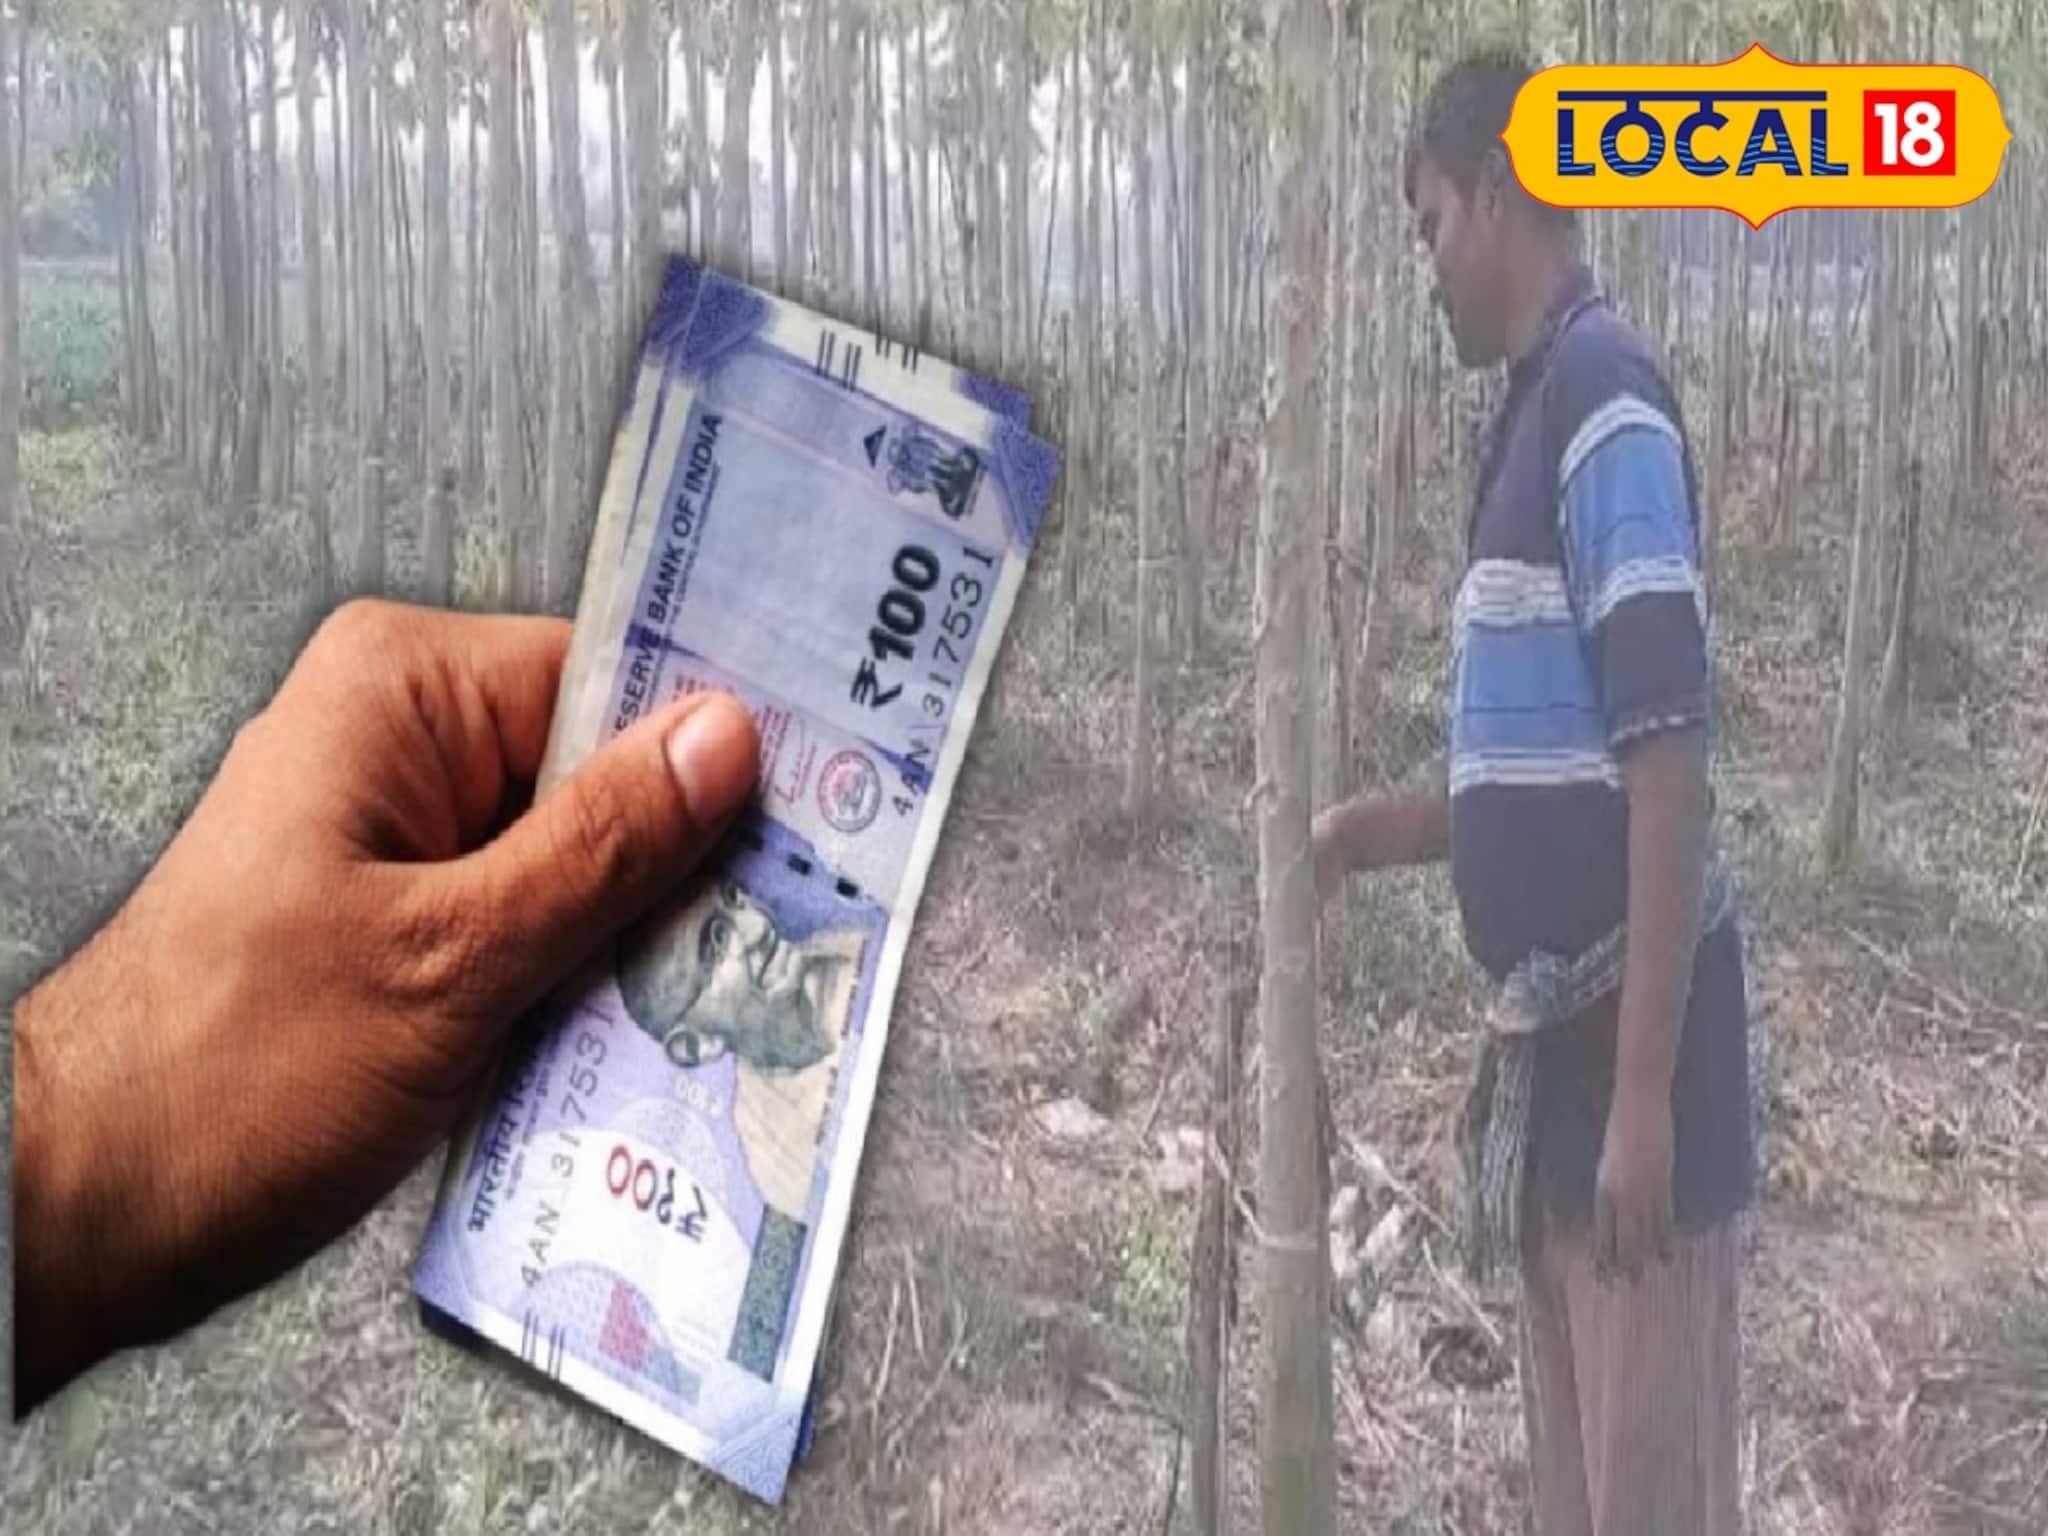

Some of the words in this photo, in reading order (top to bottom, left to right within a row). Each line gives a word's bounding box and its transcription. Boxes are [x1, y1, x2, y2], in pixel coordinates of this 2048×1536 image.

[610, 626, 661, 740] ESERVE
[648, 538, 685, 624] BANK
[671, 493, 696, 538] OF
[684, 414, 723, 494] INDIA
[850, 545, 941, 709] ₹100
[922, 546, 994, 718] 317531
[521, 1200, 560, 1288] 4AN
[551, 1002, 616, 1178] 317531
